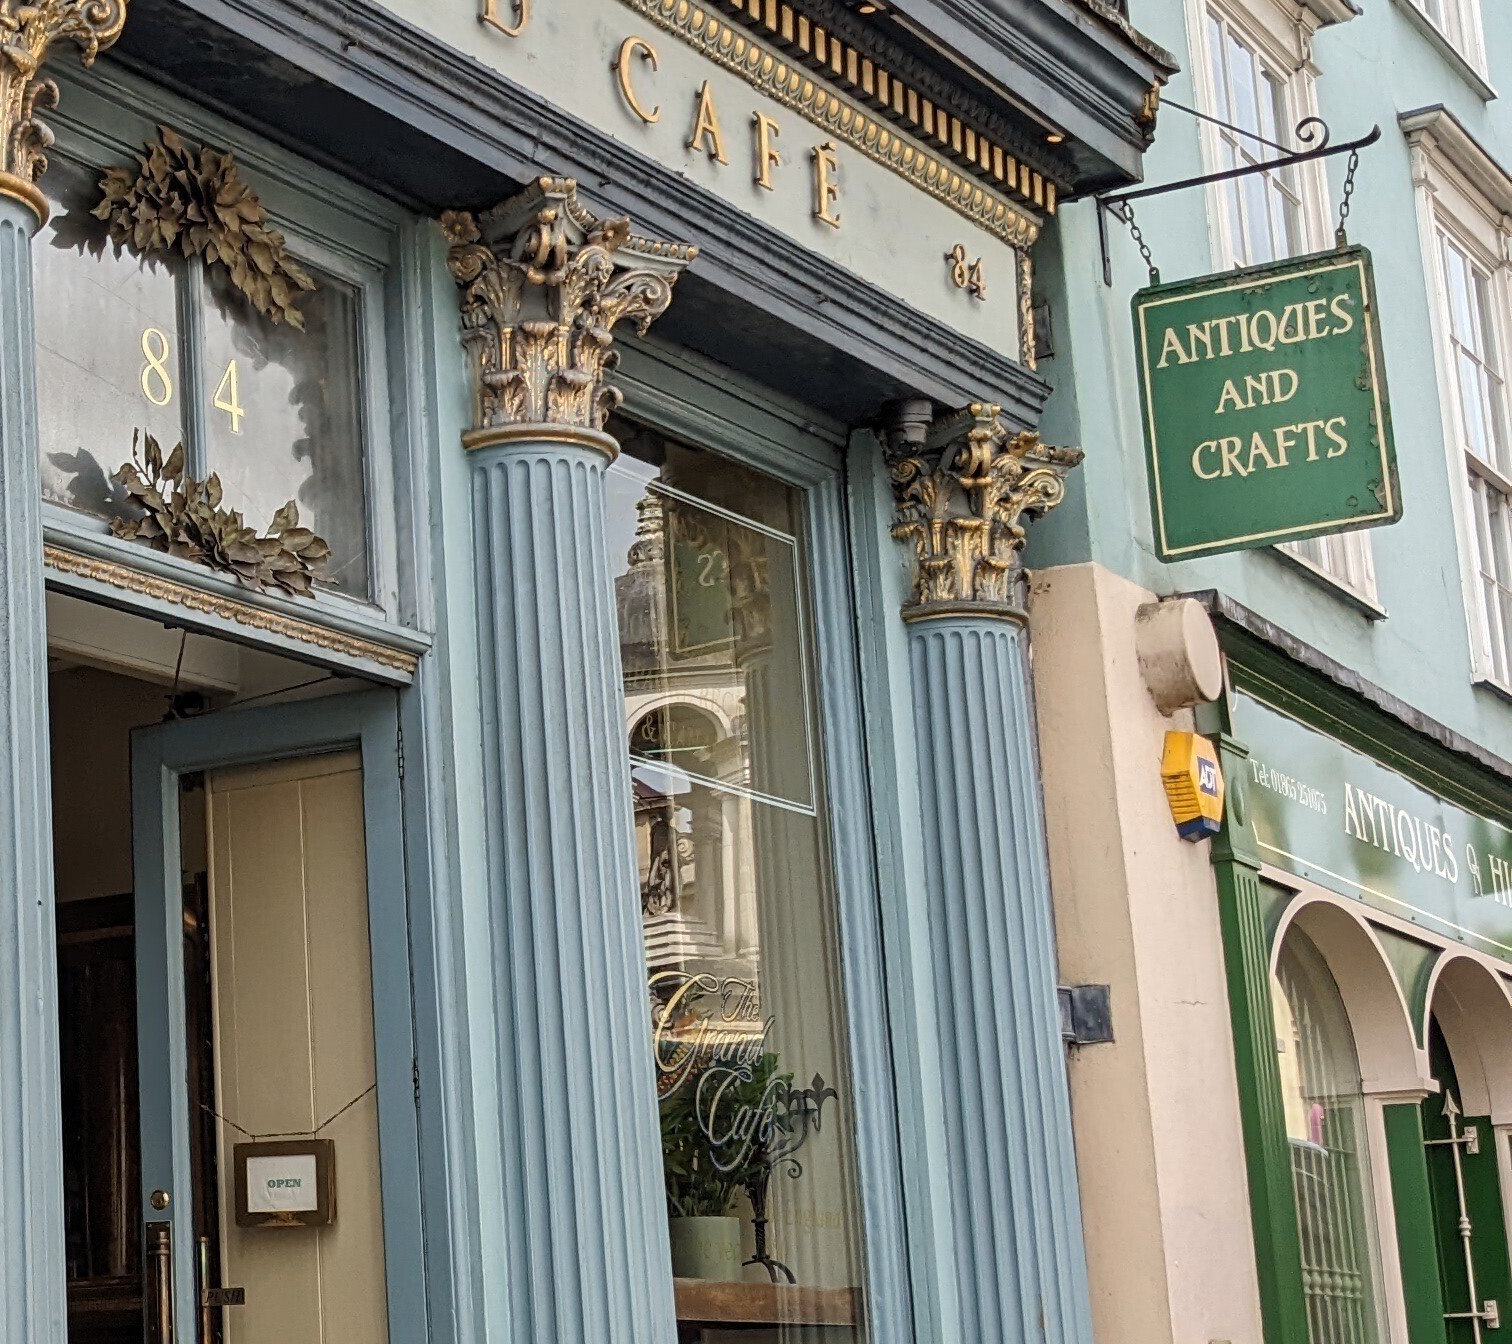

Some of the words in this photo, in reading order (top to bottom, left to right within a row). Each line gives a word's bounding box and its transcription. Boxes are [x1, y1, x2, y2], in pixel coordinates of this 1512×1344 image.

[615, 35, 840, 229] CAFÉ
[949, 243, 986, 301] 84
[1156, 293, 1354, 369] ANTIQUES
[1215, 368, 1298, 414] AND
[1192, 416, 1349, 480] CRAFTS
[1199, 763, 1216, 792] ADT
[1345, 782, 1458, 883] ANTIQUES
[267, 1178, 302, 1189] OPEN
